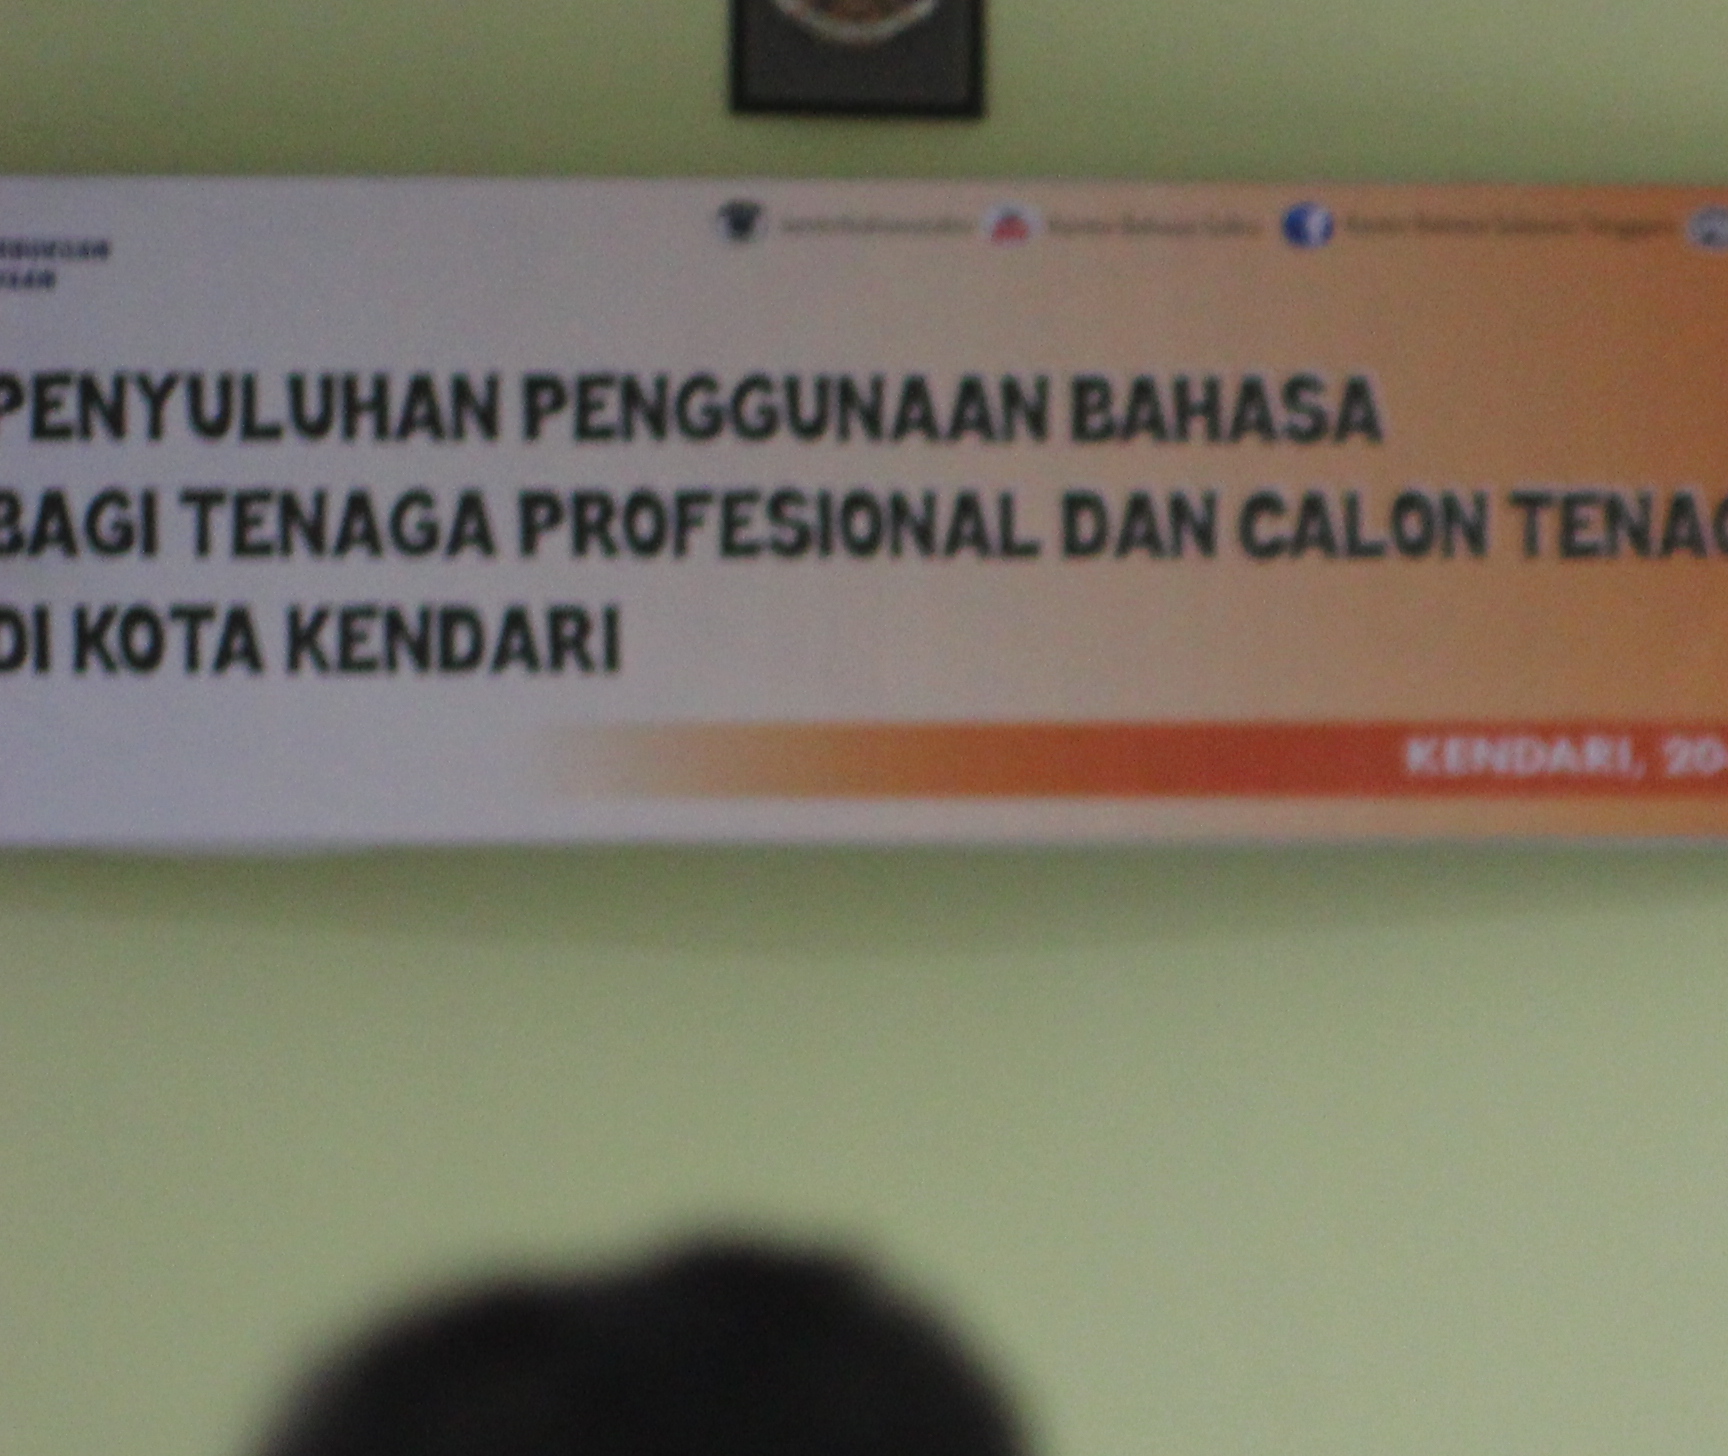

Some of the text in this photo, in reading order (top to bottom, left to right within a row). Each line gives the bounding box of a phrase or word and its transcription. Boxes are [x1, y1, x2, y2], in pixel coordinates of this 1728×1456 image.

[0, 371, 1386, 445] PENYULUHAN PENGGUNAAN BAHASA
[0, 487, 159, 557] BAGI
[178, 488, 497, 558] TENAGA
[517, 488, 1040, 560] PROFESIONAL
[1062, 490, 1220, 560] DAN
[1238, 490, 1489, 560] CALON
[0, 604, 622, 676] DI KOTA KENDARI
[1404, 735, 1645, 780] KENDARI,
